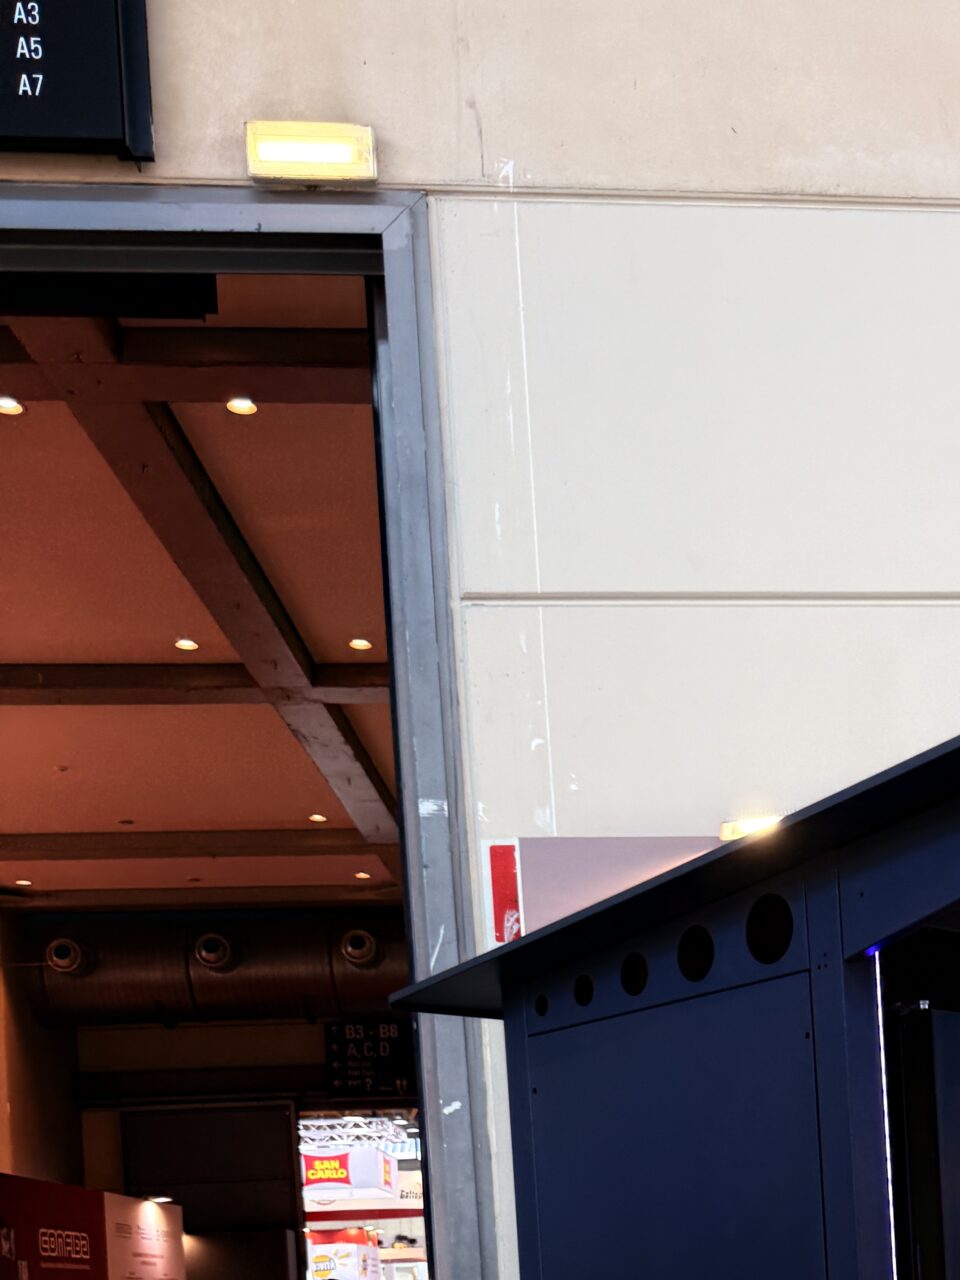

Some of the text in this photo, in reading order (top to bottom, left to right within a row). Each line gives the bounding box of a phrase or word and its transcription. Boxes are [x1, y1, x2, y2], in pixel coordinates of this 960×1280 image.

[14, 2, 40, 25] A3
[16, 36, 43, 59] A5
[18, 73, 43, 96] A7
[345, 1024, 364, 1039] B3
[307, 1168, 348, 1180] CARLO
[313, 1159, 340, 1170] SAN
